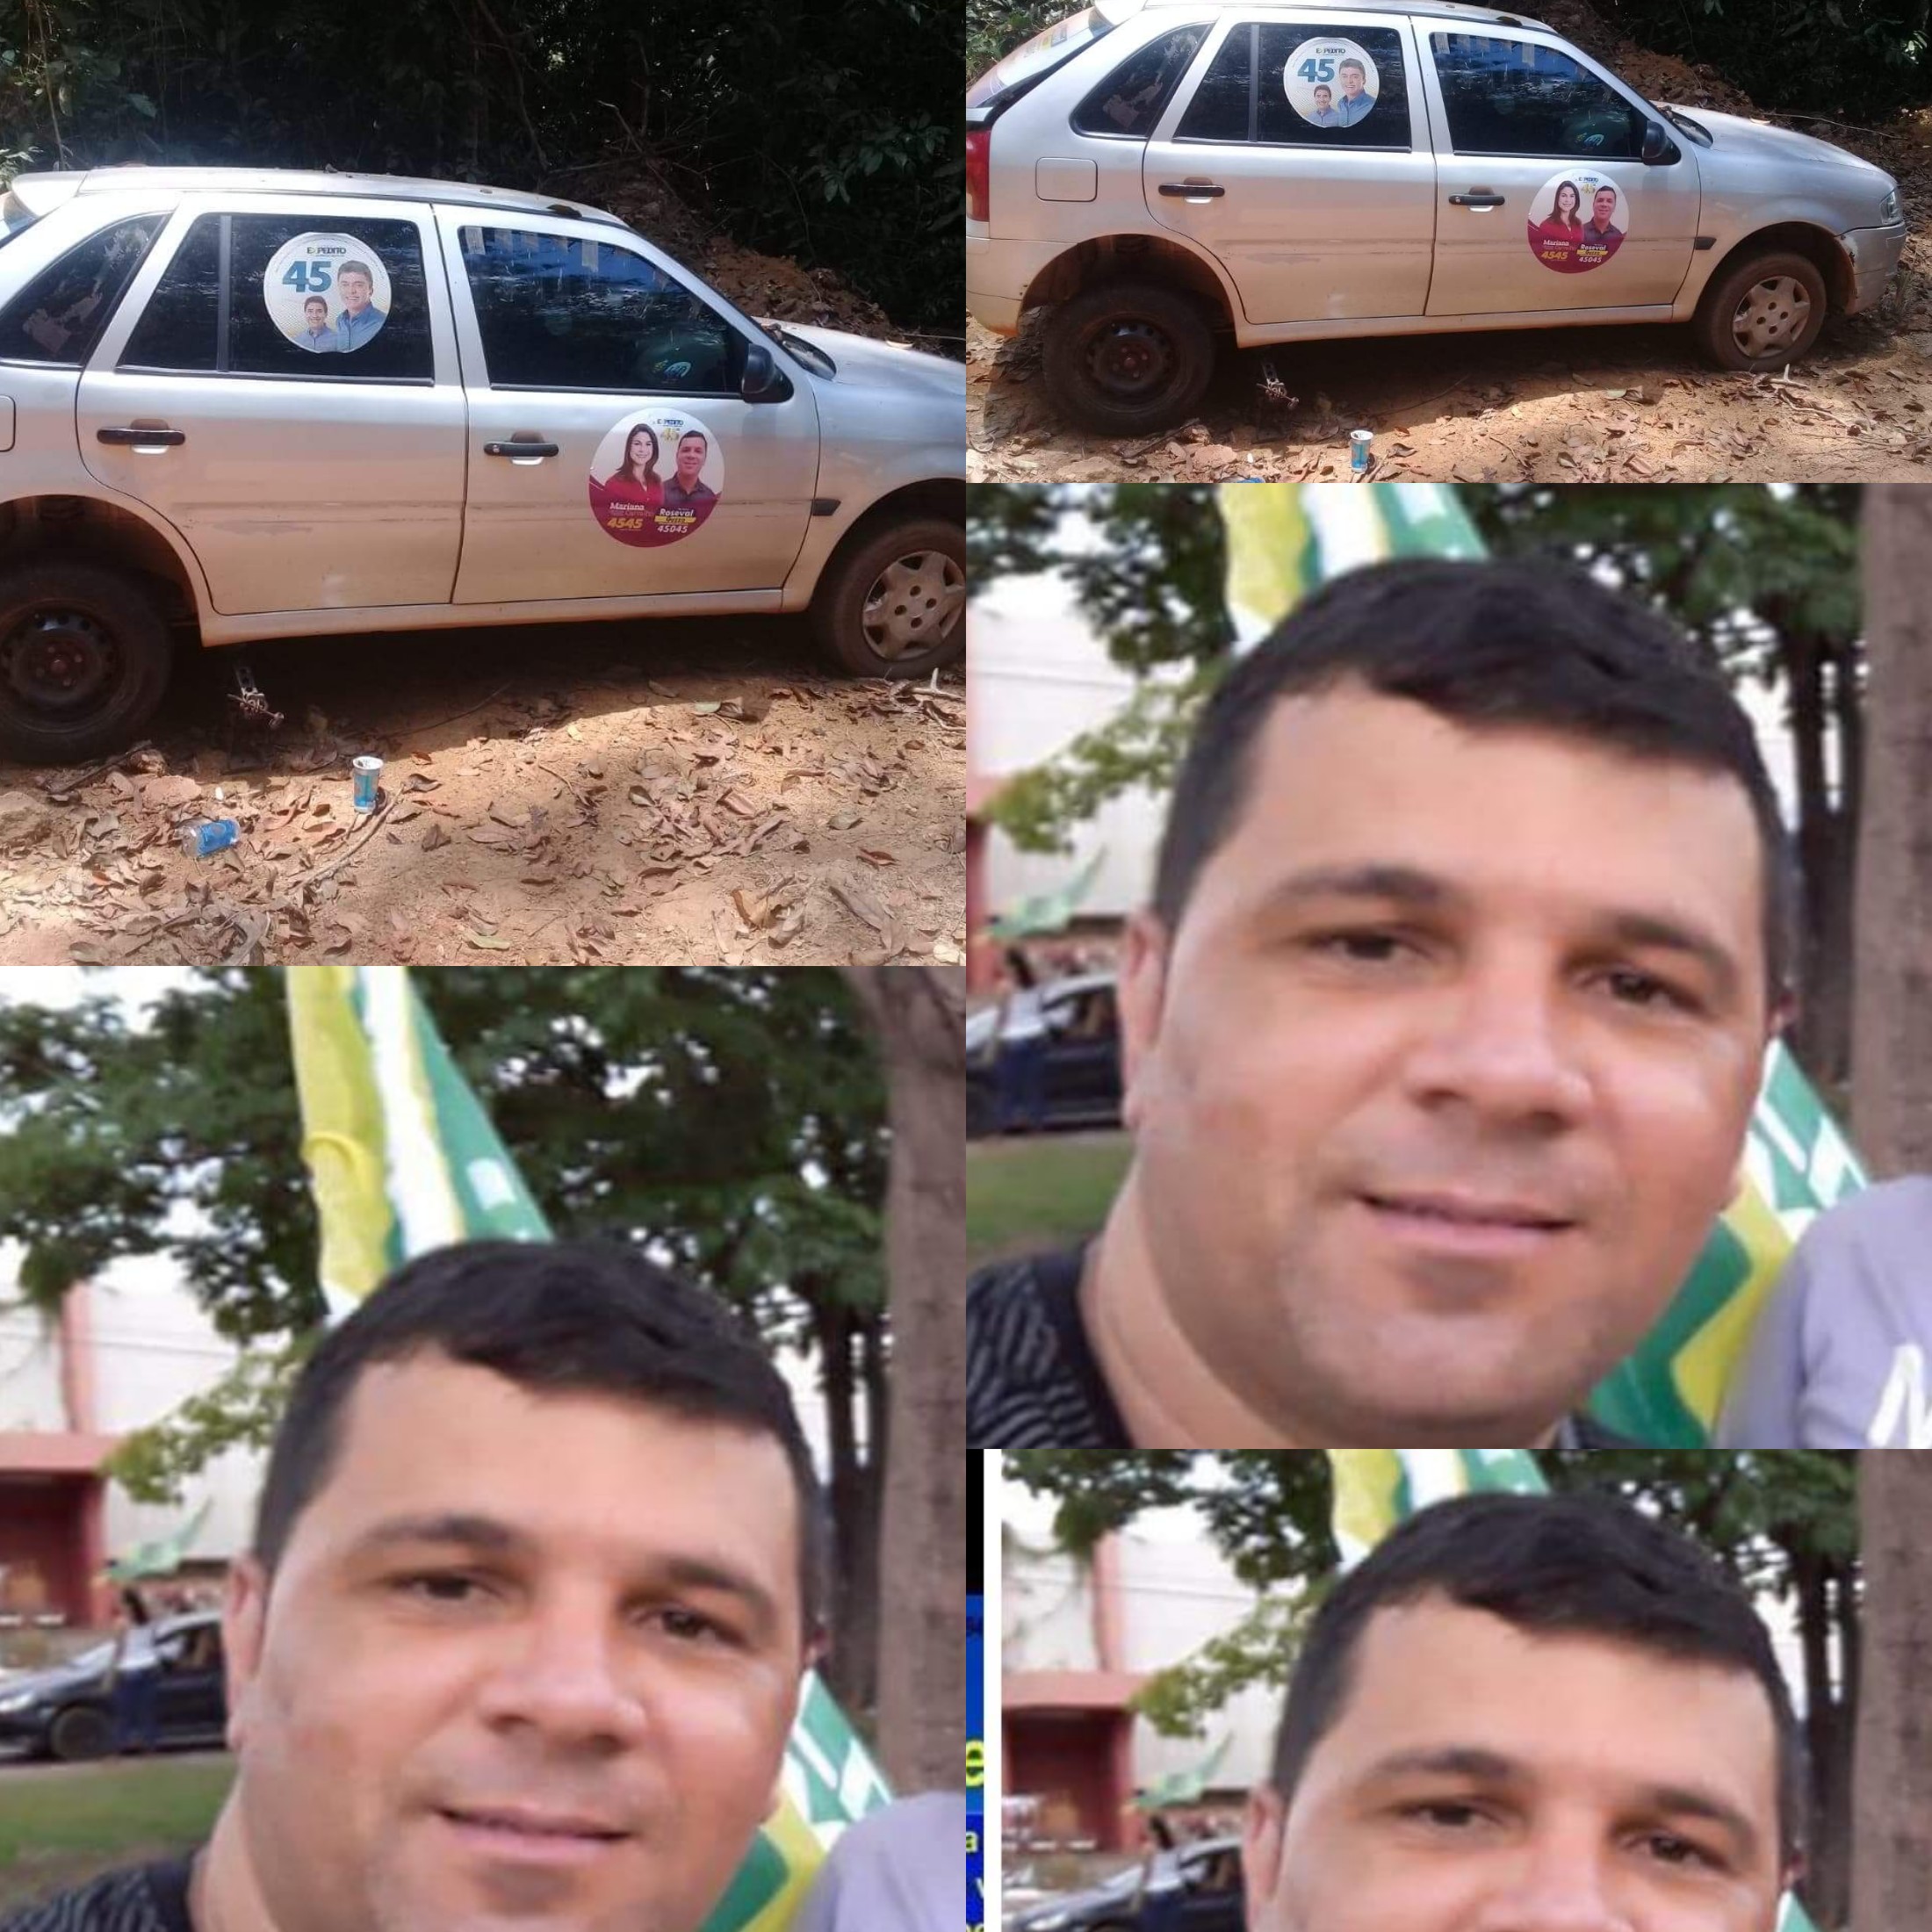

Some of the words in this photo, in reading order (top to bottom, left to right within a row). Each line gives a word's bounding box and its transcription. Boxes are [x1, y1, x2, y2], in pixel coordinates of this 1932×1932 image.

[1297, 59, 1335, 83] 45
[1541, 251, 1568, 260] 4545
[282, 260, 332, 292] 45
[609, 502, 645, 511] Mariana
[607, 517, 643, 529] 4545
